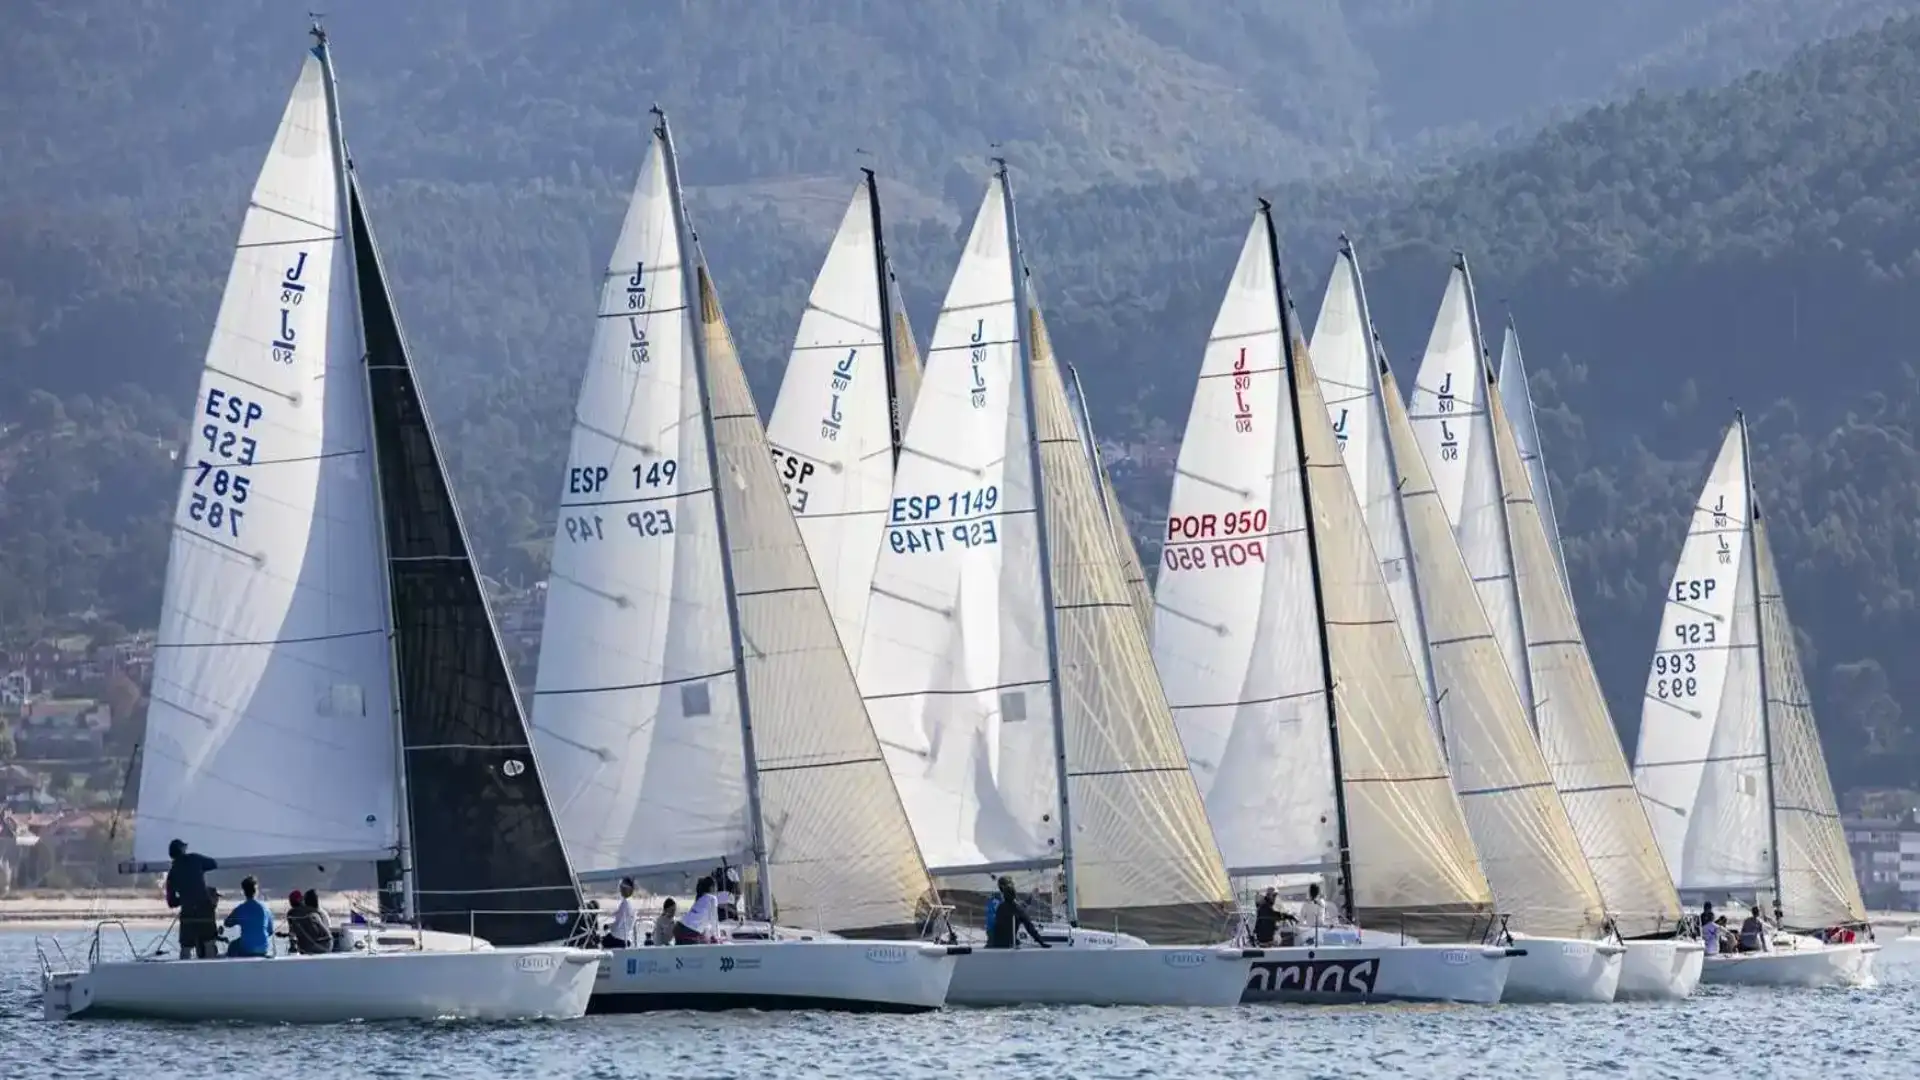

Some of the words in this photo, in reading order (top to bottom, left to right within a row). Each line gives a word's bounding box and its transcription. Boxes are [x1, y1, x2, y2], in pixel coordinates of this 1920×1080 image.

[286, 252, 307, 281] J
[630, 262, 643, 286] J
[280, 290, 303, 305] 80
[628, 293, 645, 309] 80
[971, 319, 984, 342] J
[838, 349, 857, 371] J
[971, 349, 987, 364] 80
[1234, 348, 1246, 370] J
[831, 378, 848, 392] 80
[1234, 376, 1250, 390] 80
[1440, 373, 1452, 393] J
[206, 387, 262, 428] ESP
[1438, 400, 1454, 413] 80
[1333, 408, 1348, 432] J
[194, 461, 250, 504] 785
[570, 466, 608, 493] ESP
[632, 459, 677, 490] 149
[892, 495, 941, 522] ESP
[948, 485, 998, 517] 1149
[1168, 514, 1217, 540] POR
[1224, 508, 1267, 535] 950
[1676, 578, 1716, 601] ESP
[1656, 653, 1696, 675] 993
